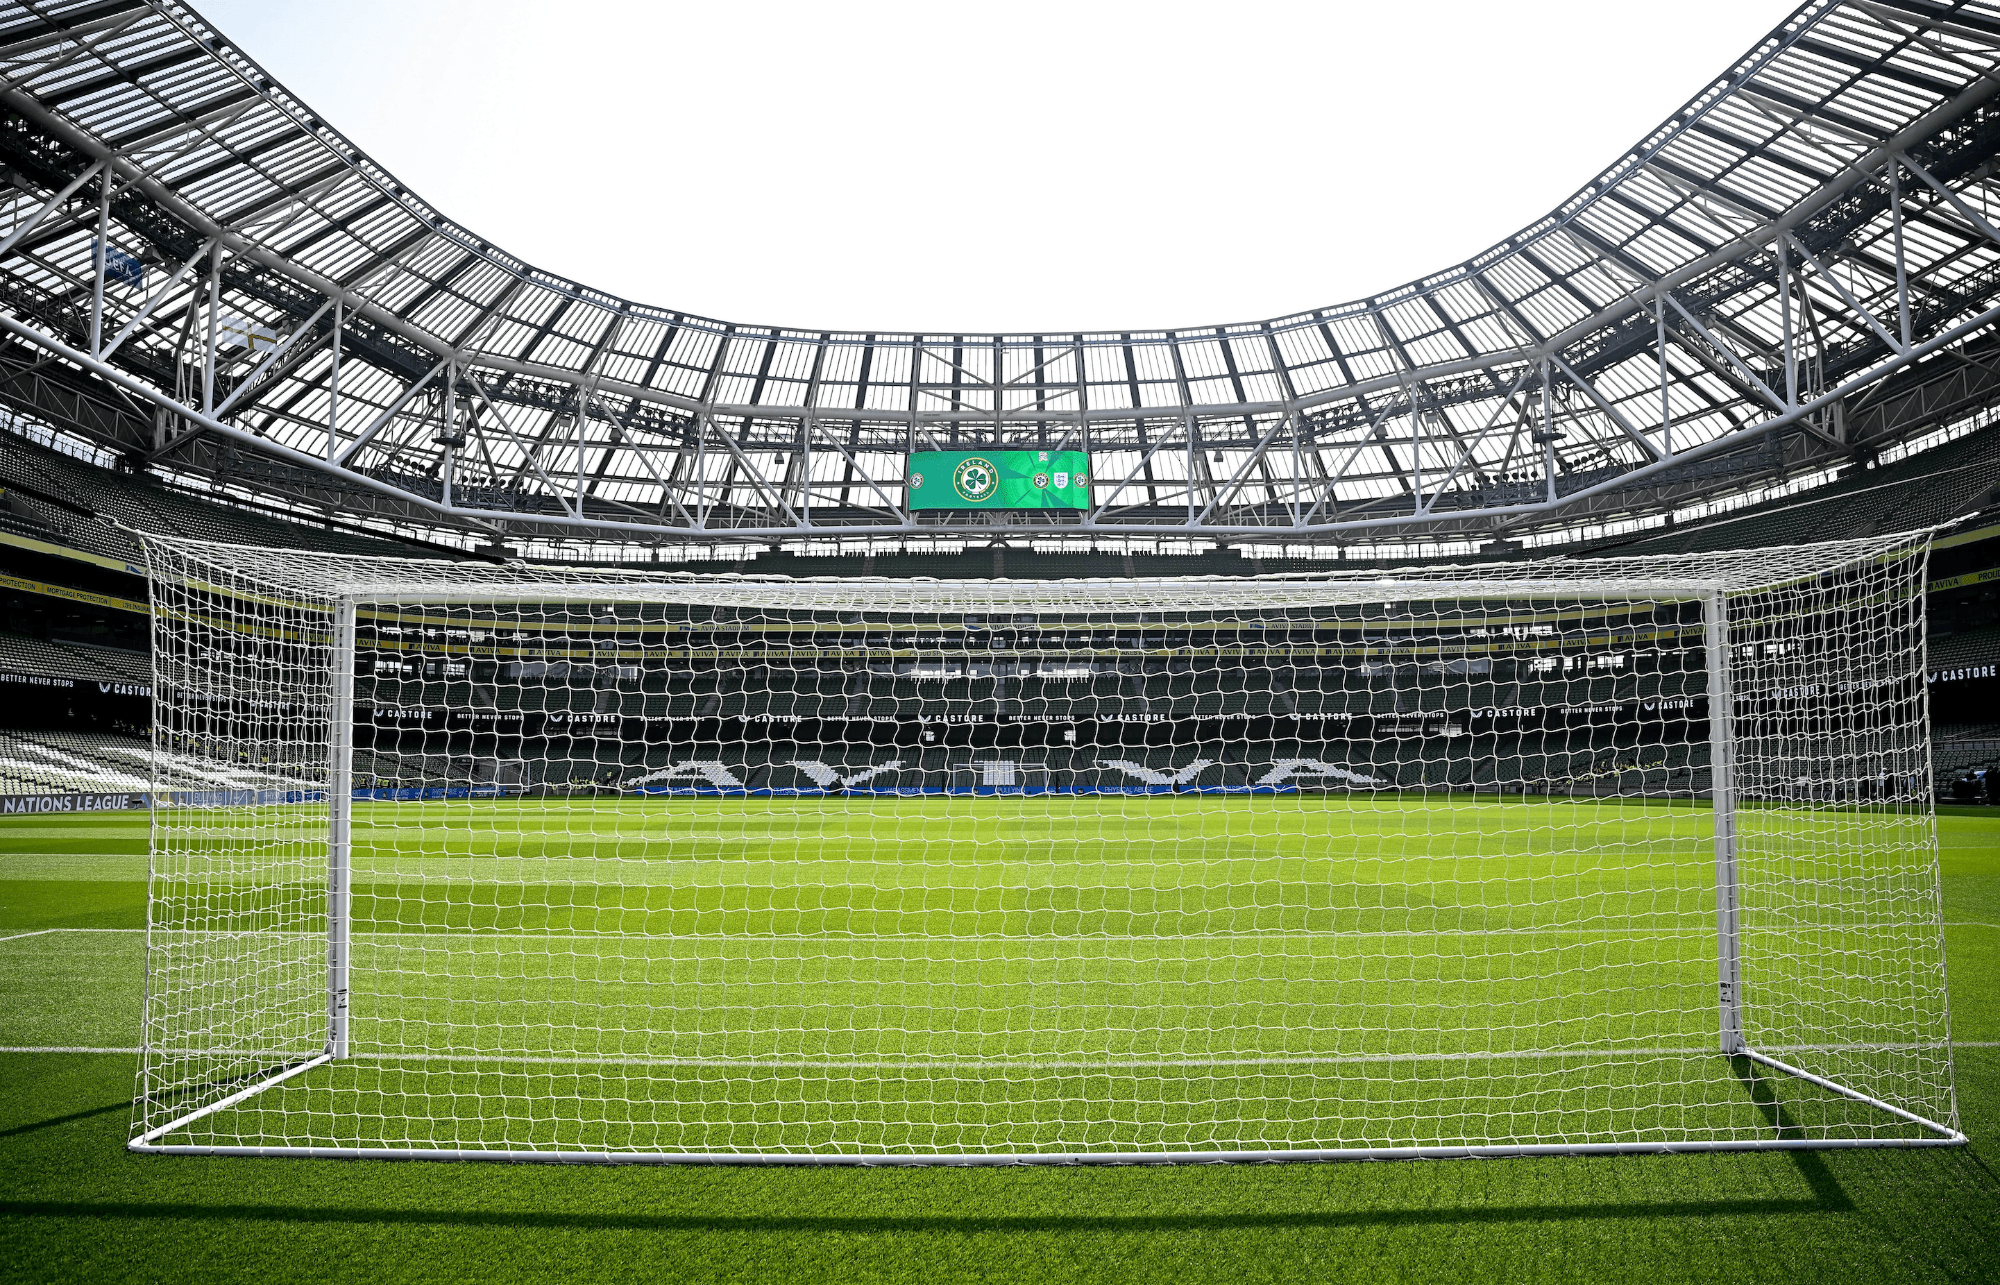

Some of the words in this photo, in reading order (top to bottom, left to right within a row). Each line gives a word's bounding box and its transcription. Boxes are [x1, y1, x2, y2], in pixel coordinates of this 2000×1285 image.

[958, 460, 994, 474] IRELAND
[1934, 578, 1958, 590] AVIVA
[47, 586, 76, 598] MORTGAGE
[76, 592, 108, 604] PROTECTION
[359, 639, 382, 647] AVIVA
[416, 643, 440, 651] AVIVA
[1942, 666, 1996, 682] CASTORE
[0, 674, 26, 684] BETTER
[30, 676, 50, 686] NEVER
[53, 679, 74, 688] STOPS
[114, 684, 152, 697] CASTOR
[1658, 700, 1694, 710] CASTORE
[388, 710, 432, 719] CASTORE
[1487, 708, 1536, 718] CASTORE
[4, 796, 72, 813] NATIONS
[76, 795, 129, 811] LEAGUE
